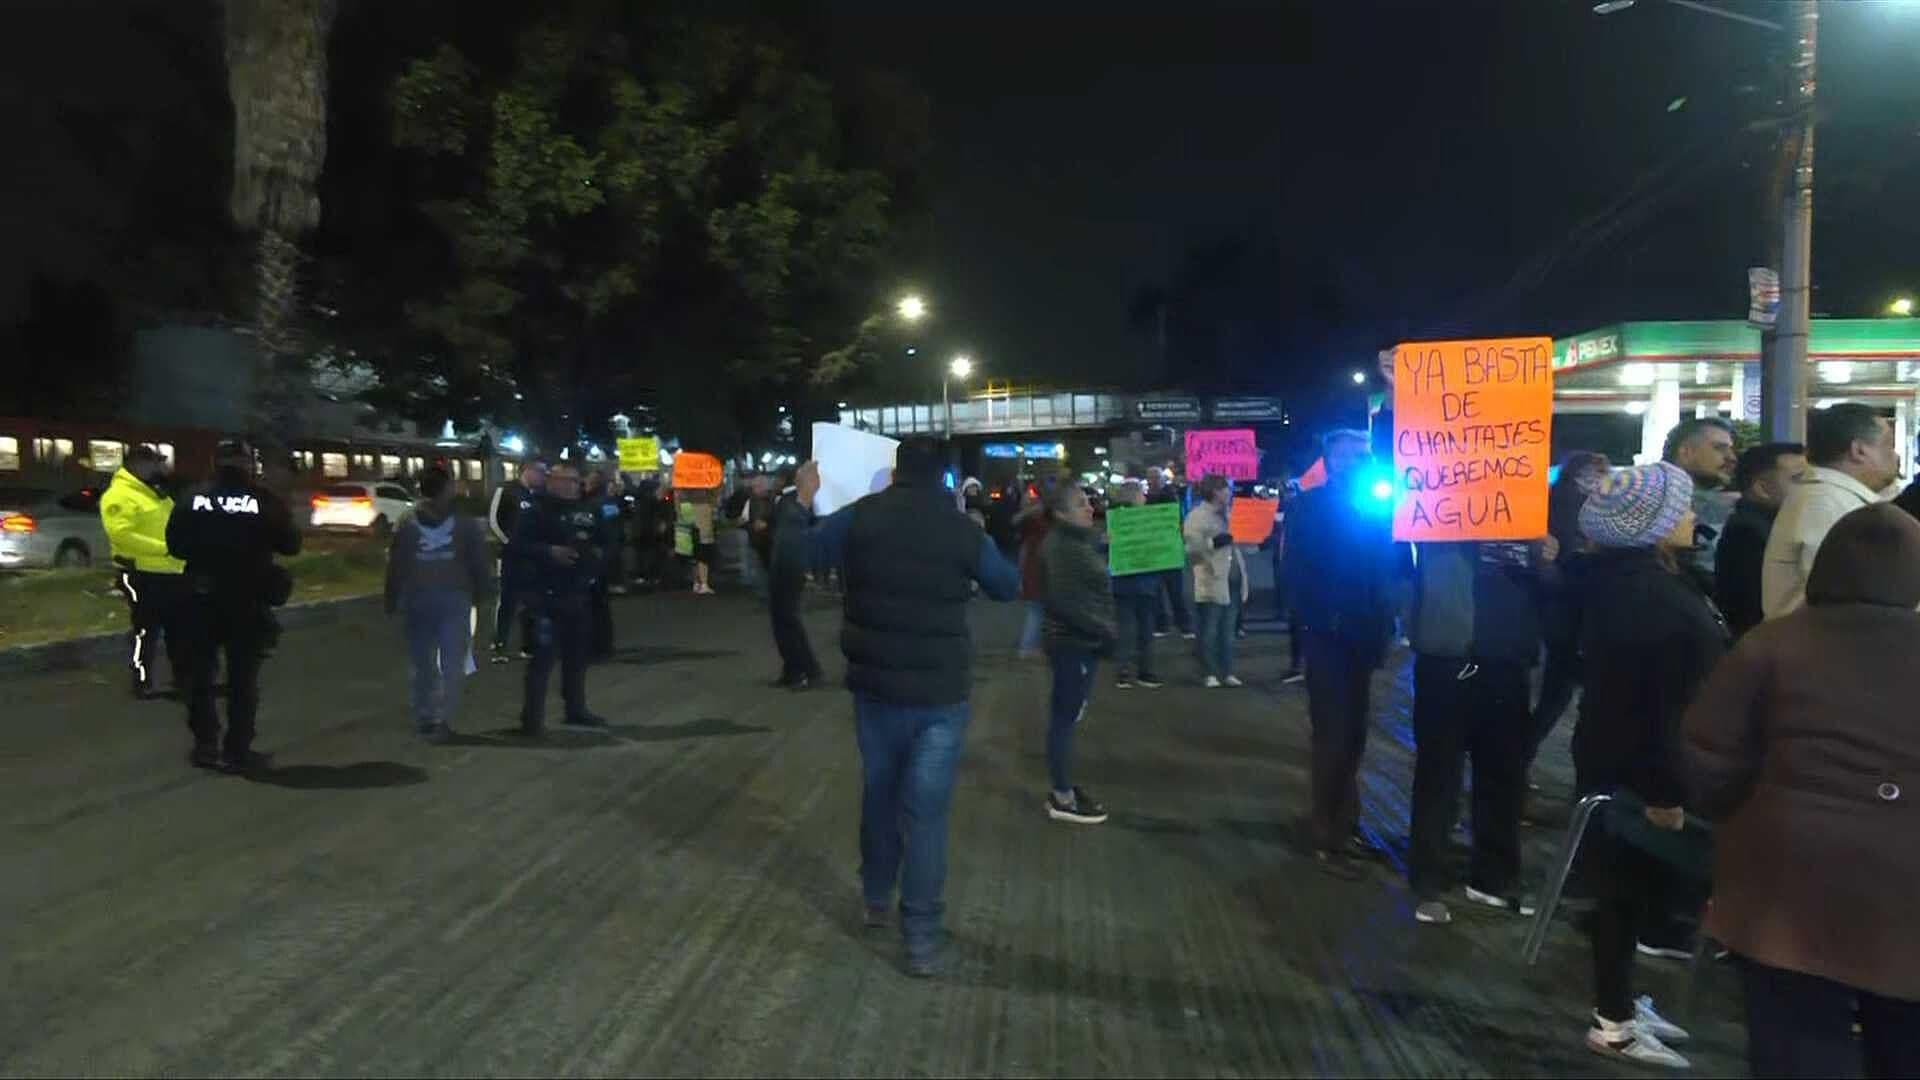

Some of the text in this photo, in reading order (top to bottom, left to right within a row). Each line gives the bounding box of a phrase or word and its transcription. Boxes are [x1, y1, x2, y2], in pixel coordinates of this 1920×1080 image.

[1403, 344, 1549, 395] YA BASTA
[1441, 391, 1481, 421] DE
[1398, 420, 1545, 457] CHANTAJES
[1404, 455, 1533, 492] QUEREMOS
[1411, 491, 1512, 529] AGUA
